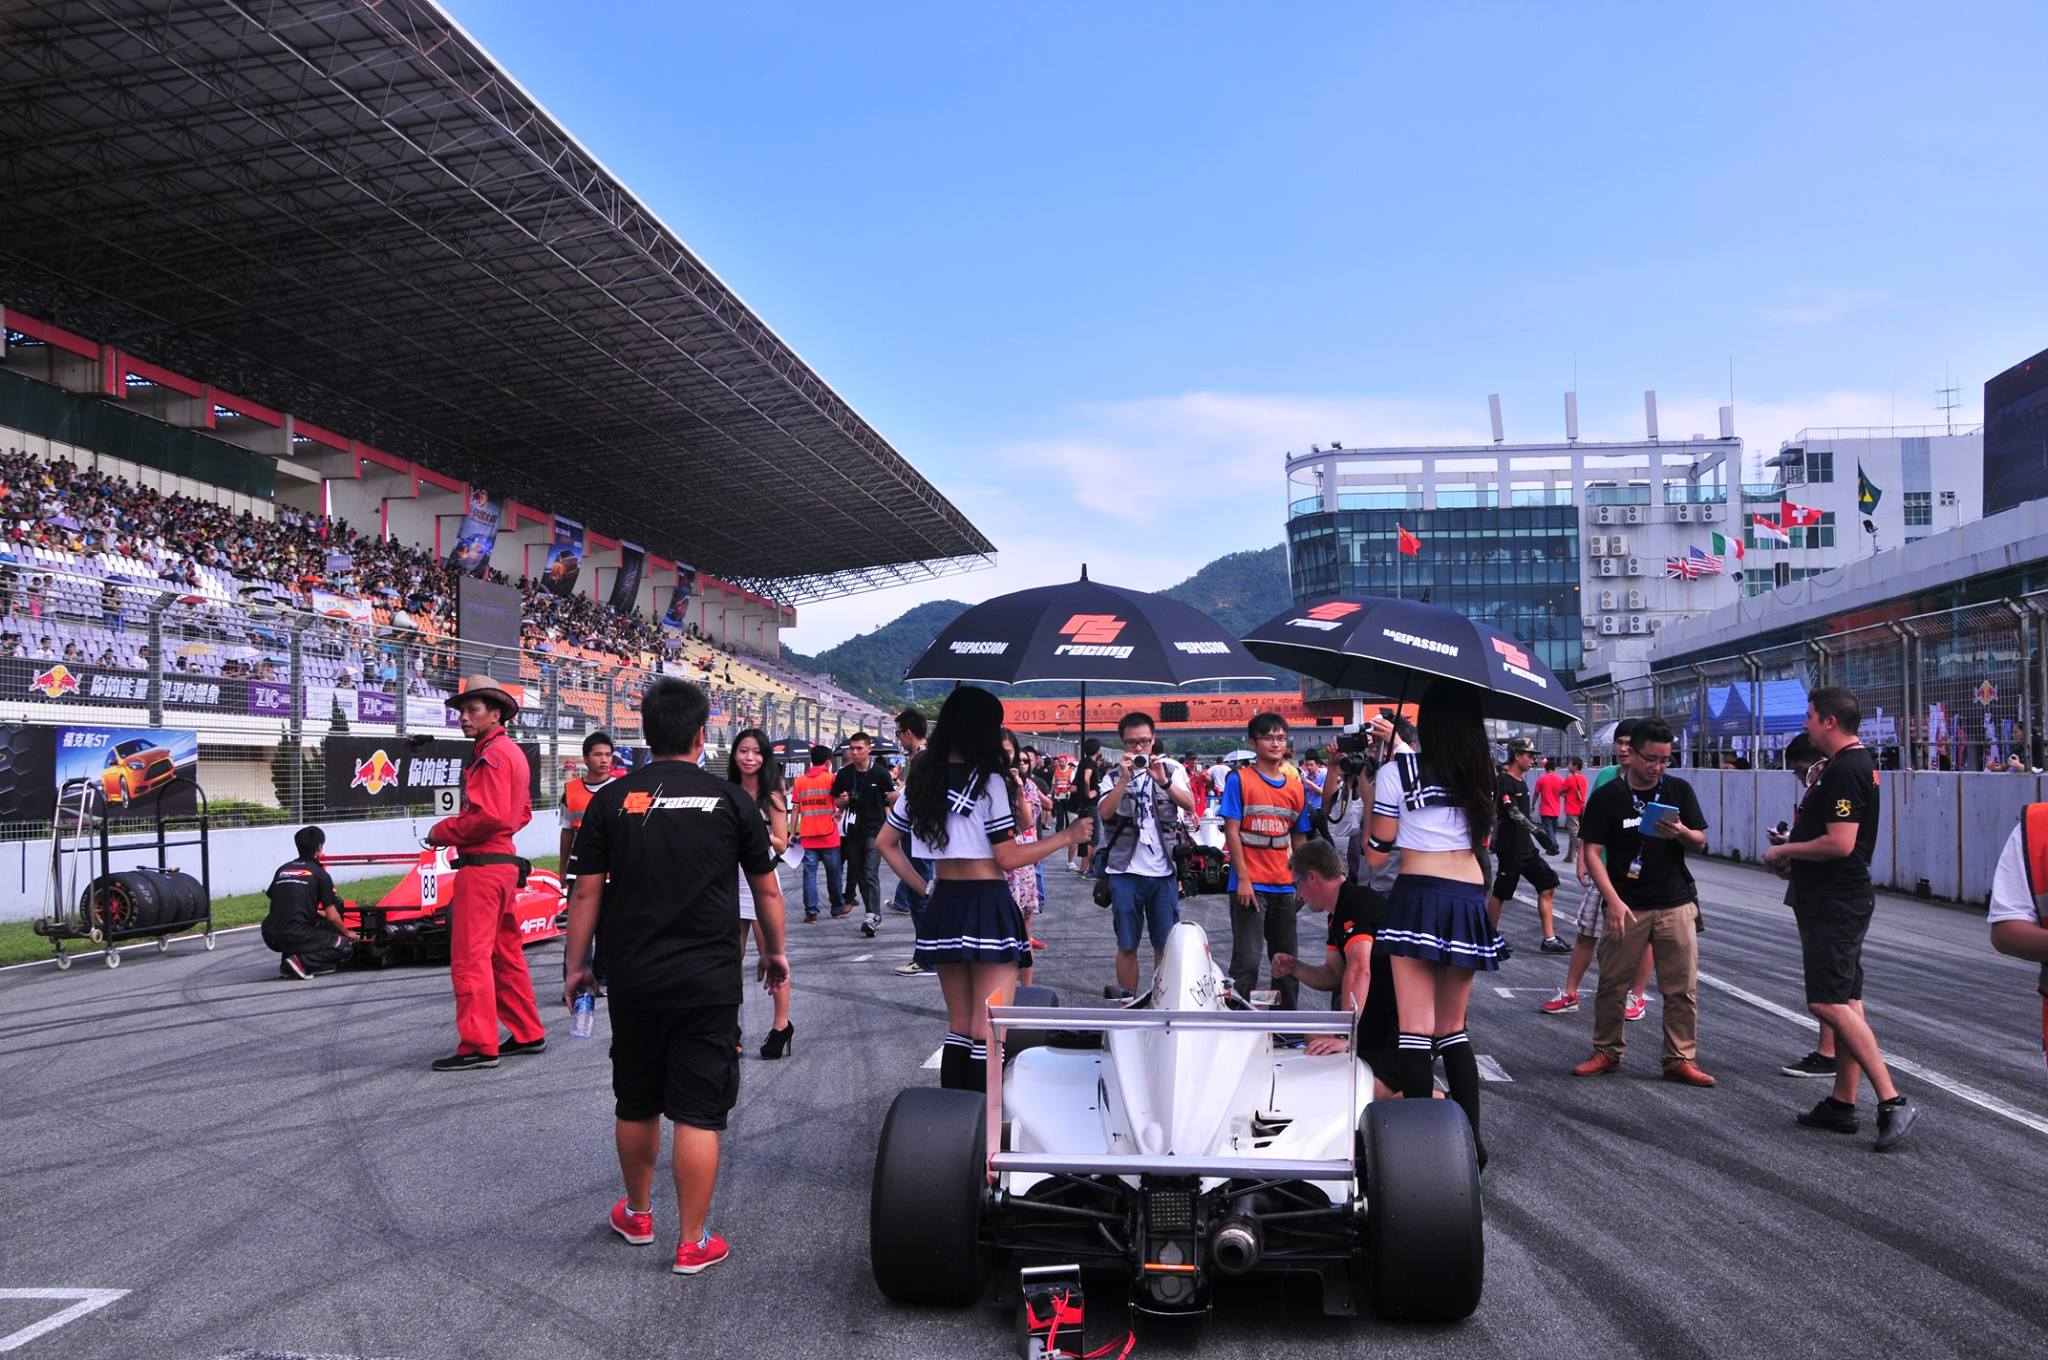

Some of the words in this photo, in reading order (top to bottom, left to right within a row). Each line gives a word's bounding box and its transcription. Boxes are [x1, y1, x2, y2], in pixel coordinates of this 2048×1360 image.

[1054, 644, 1135, 659] racing
[1405, 635, 1459, 657] PASSION
[256, 688, 280, 708] ZIC
[363, 698, 382, 716] ZIC
[1014, 711, 1046, 721] 2013
[1210, 706, 1244, 719] 2013
[407, 758, 462, 787] 你的能量
[441, 791, 454, 811] 9
[423, 874, 436, 899] 88
